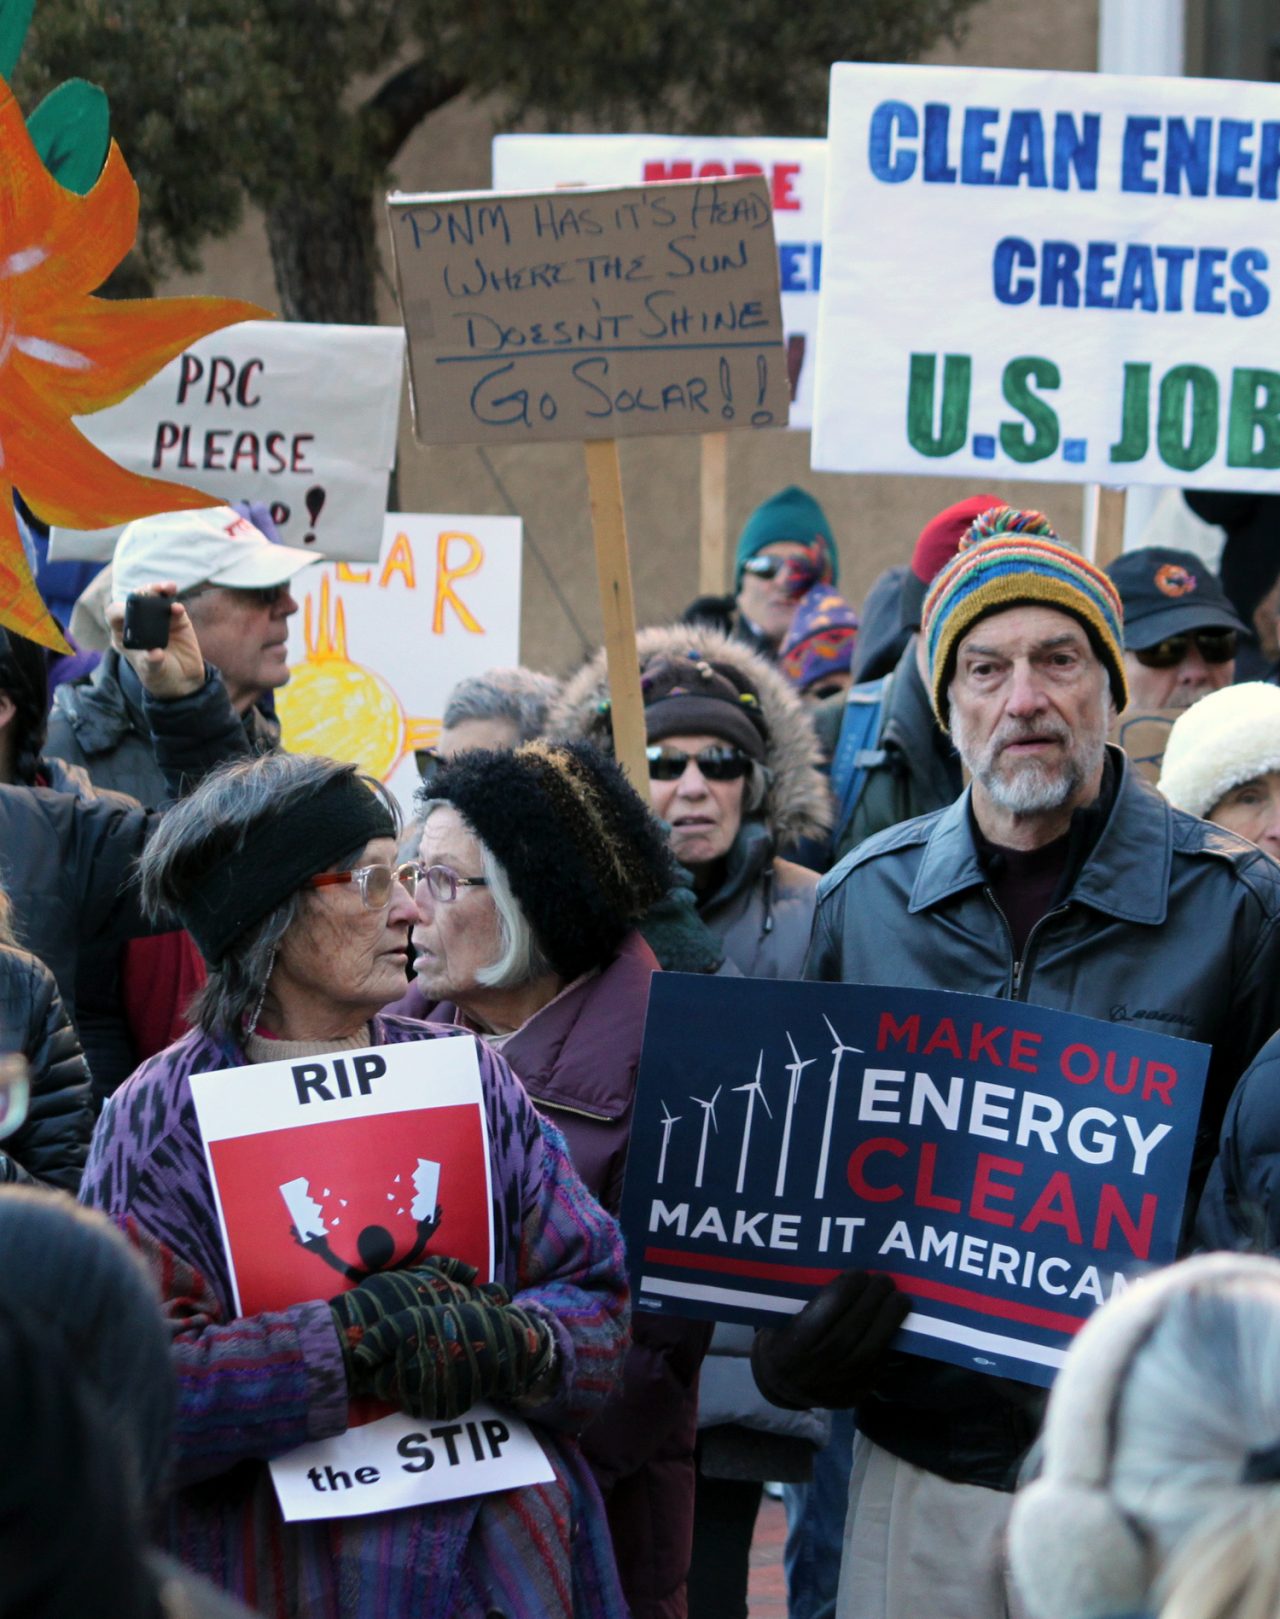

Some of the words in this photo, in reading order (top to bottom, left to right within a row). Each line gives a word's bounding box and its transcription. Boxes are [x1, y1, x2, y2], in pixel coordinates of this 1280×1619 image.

[868, 100, 1101, 191] CLEAN
[402, 205, 511, 249] PNM
[535, 200, 603, 241] HAS
[615, 192, 676, 230] IT'S
[692, 184, 771, 230] HEAD
[444, 258, 571, 297] WHERE
[576, 254, 653, 284] THE
[667, 235, 747, 278] SUN
[992, 235, 1271, 318] CREATES
[452, 297, 634, 350] DOESN'T
[640, 290, 769, 339] SHINE
[176, 352, 264, 407] PRC
[470, 361, 557, 427] GO
[907, 352, 1087, 464] U.S.
[152, 421, 315, 474] PLEASE
[291, 1053, 388, 1106] RIP
[876, 1011, 1044, 1074] MAKE
[1059, 1043, 1179, 1106] OUR
[857, 1068, 1173, 1176] ENERGY
[648, 1200, 802, 1250] MAKE
[818, 1216, 866, 1254] IT
[846, 1137, 1158, 1261] CLEAN
[307, 1464, 382, 1493] the
[396, 1419, 511, 1475] STIP
